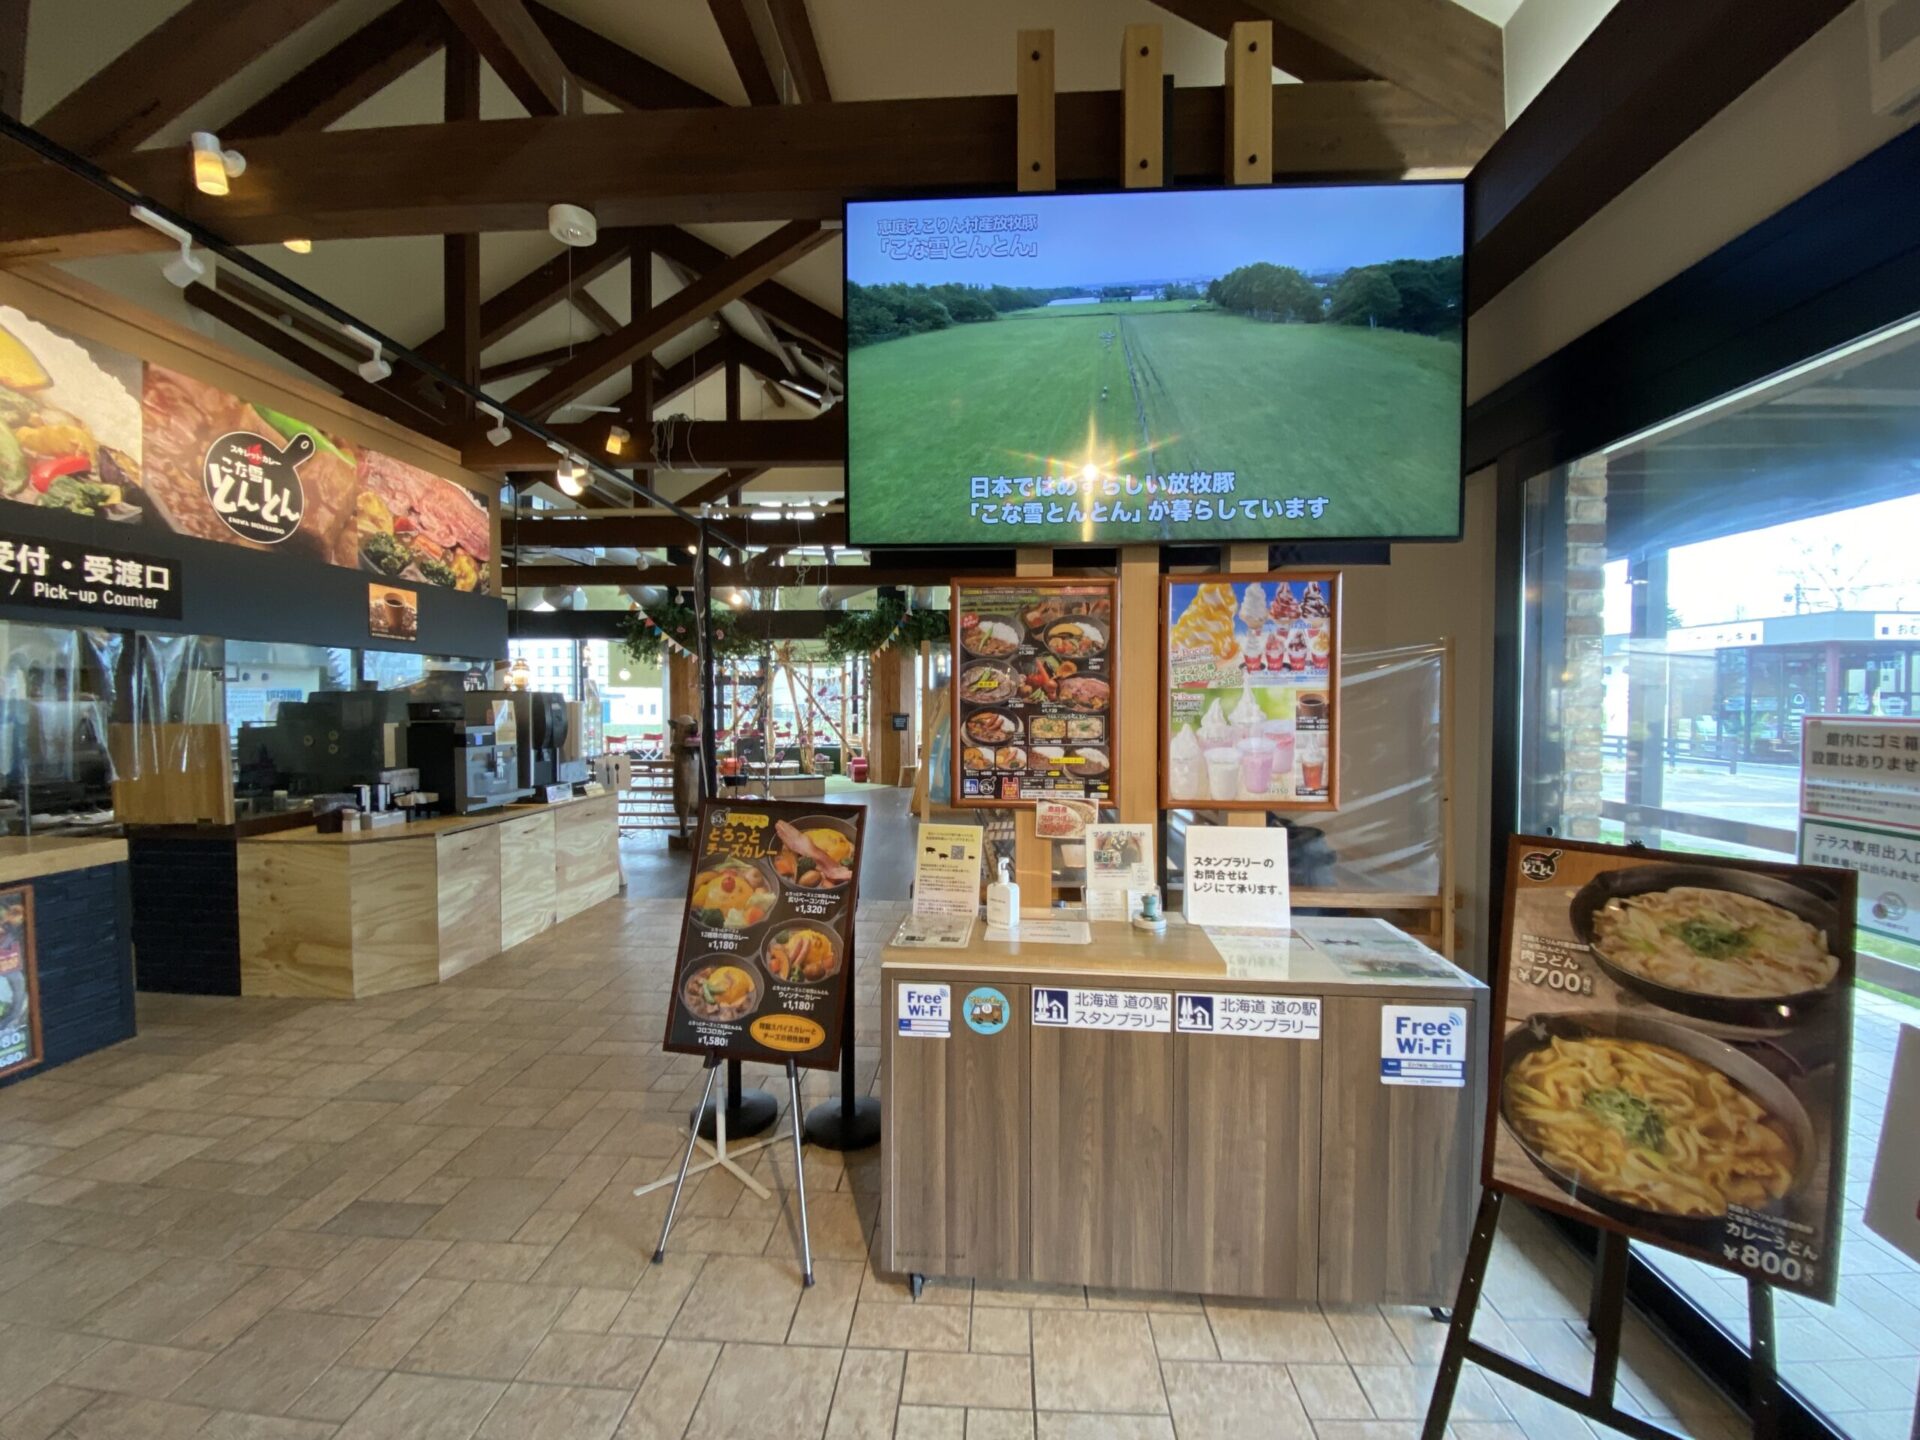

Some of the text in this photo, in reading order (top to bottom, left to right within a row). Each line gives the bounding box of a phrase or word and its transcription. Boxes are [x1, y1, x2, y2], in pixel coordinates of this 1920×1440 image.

[877, 213, 1038, 236] 恵庭えこりん村産放牧豚
[880, 234, 1038, 260] 「こな雪とんとん」
[221, 456, 264, 484] こな雪
[208, 463, 300, 524] とんとん
[33, 582, 98, 604] Pick-up
[102, 589, 159, 610] Counter
[1826, 732, 1919, 752] 館内にゴミ箱
[1811, 750, 1919, 773] 設置はありませ
[709, 827, 761, 844] とろっと
[706, 843, 778, 859] チーズカレー
[1193, 870, 1249, 882] お問合せは
[1193, 883, 1284, 896] レジにて承ります。
[1520, 951, 1579, 971] 肉うどん
[1518, 965, 1582, 993] ¥700
[778, 991, 822, 1001] ウィンナーカレー
[907, 990, 942, 1004] Free
[1075, 992, 1169, 1011] 北海道 道の駅
[907, 1005, 942, 1017] Wi-Fi
[1220, 998, 1318, 1016] 北海道 道の駅
[1075, 1011, 1171, 1028] スタンプラリー
[1220, 1017, 1320, 1034] スタンプラリー
[1396, 1016, 1452, 1036] Free
[696, 1026, 733, 1036] コロコロカレー
[1396, 1037, 1452, 1056] Wi-Fi
[1725, 1222, 1819, 1261] カレーうどん
[1723, 1243, 1801, 1281] ¥800
